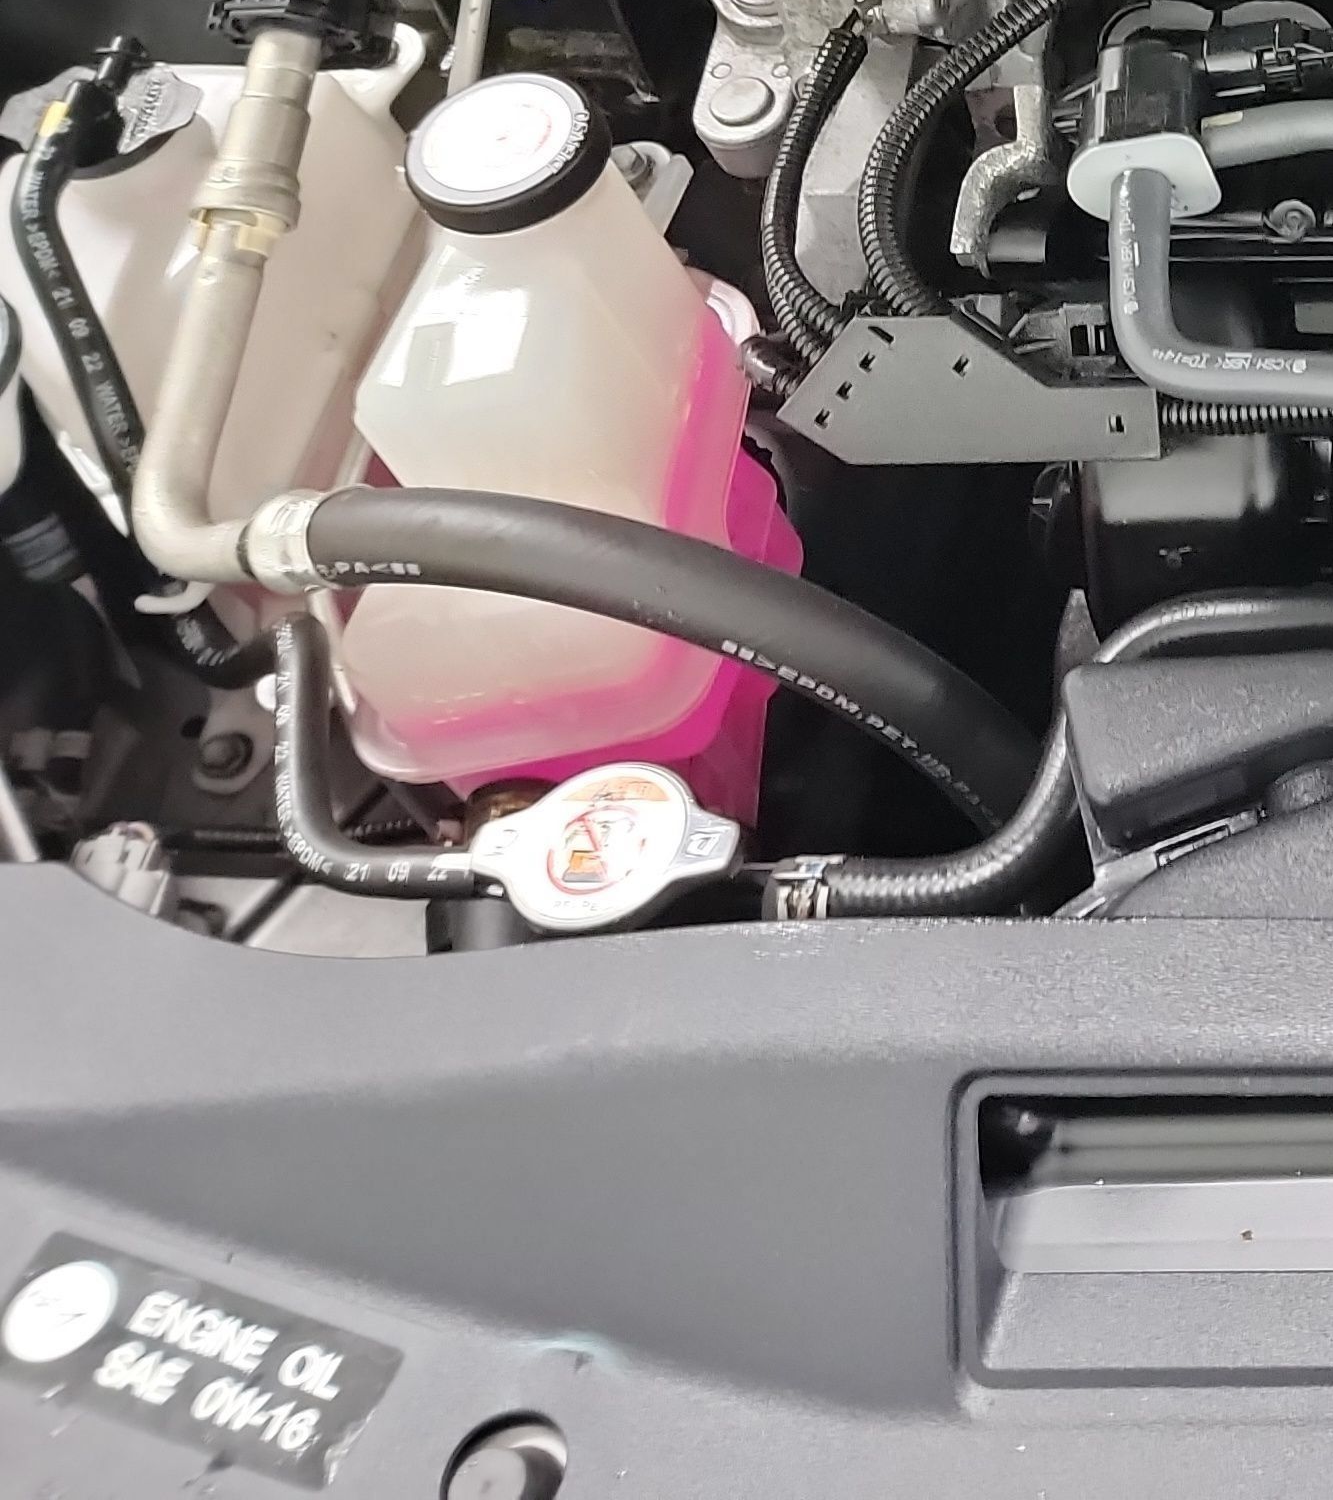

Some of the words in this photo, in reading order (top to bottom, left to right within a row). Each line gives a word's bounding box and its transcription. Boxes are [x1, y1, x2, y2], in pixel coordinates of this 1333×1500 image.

[548, 110, 590, 174] DENSO
[345, 862, 369, 882] 21
[126, 1290, 280, 1373] ENGINE
[277, 1344, 346, 1401] OIL
[93, 1340, 195, 1406] SAE
[190, 1376, 321, 1452] 0W-16
